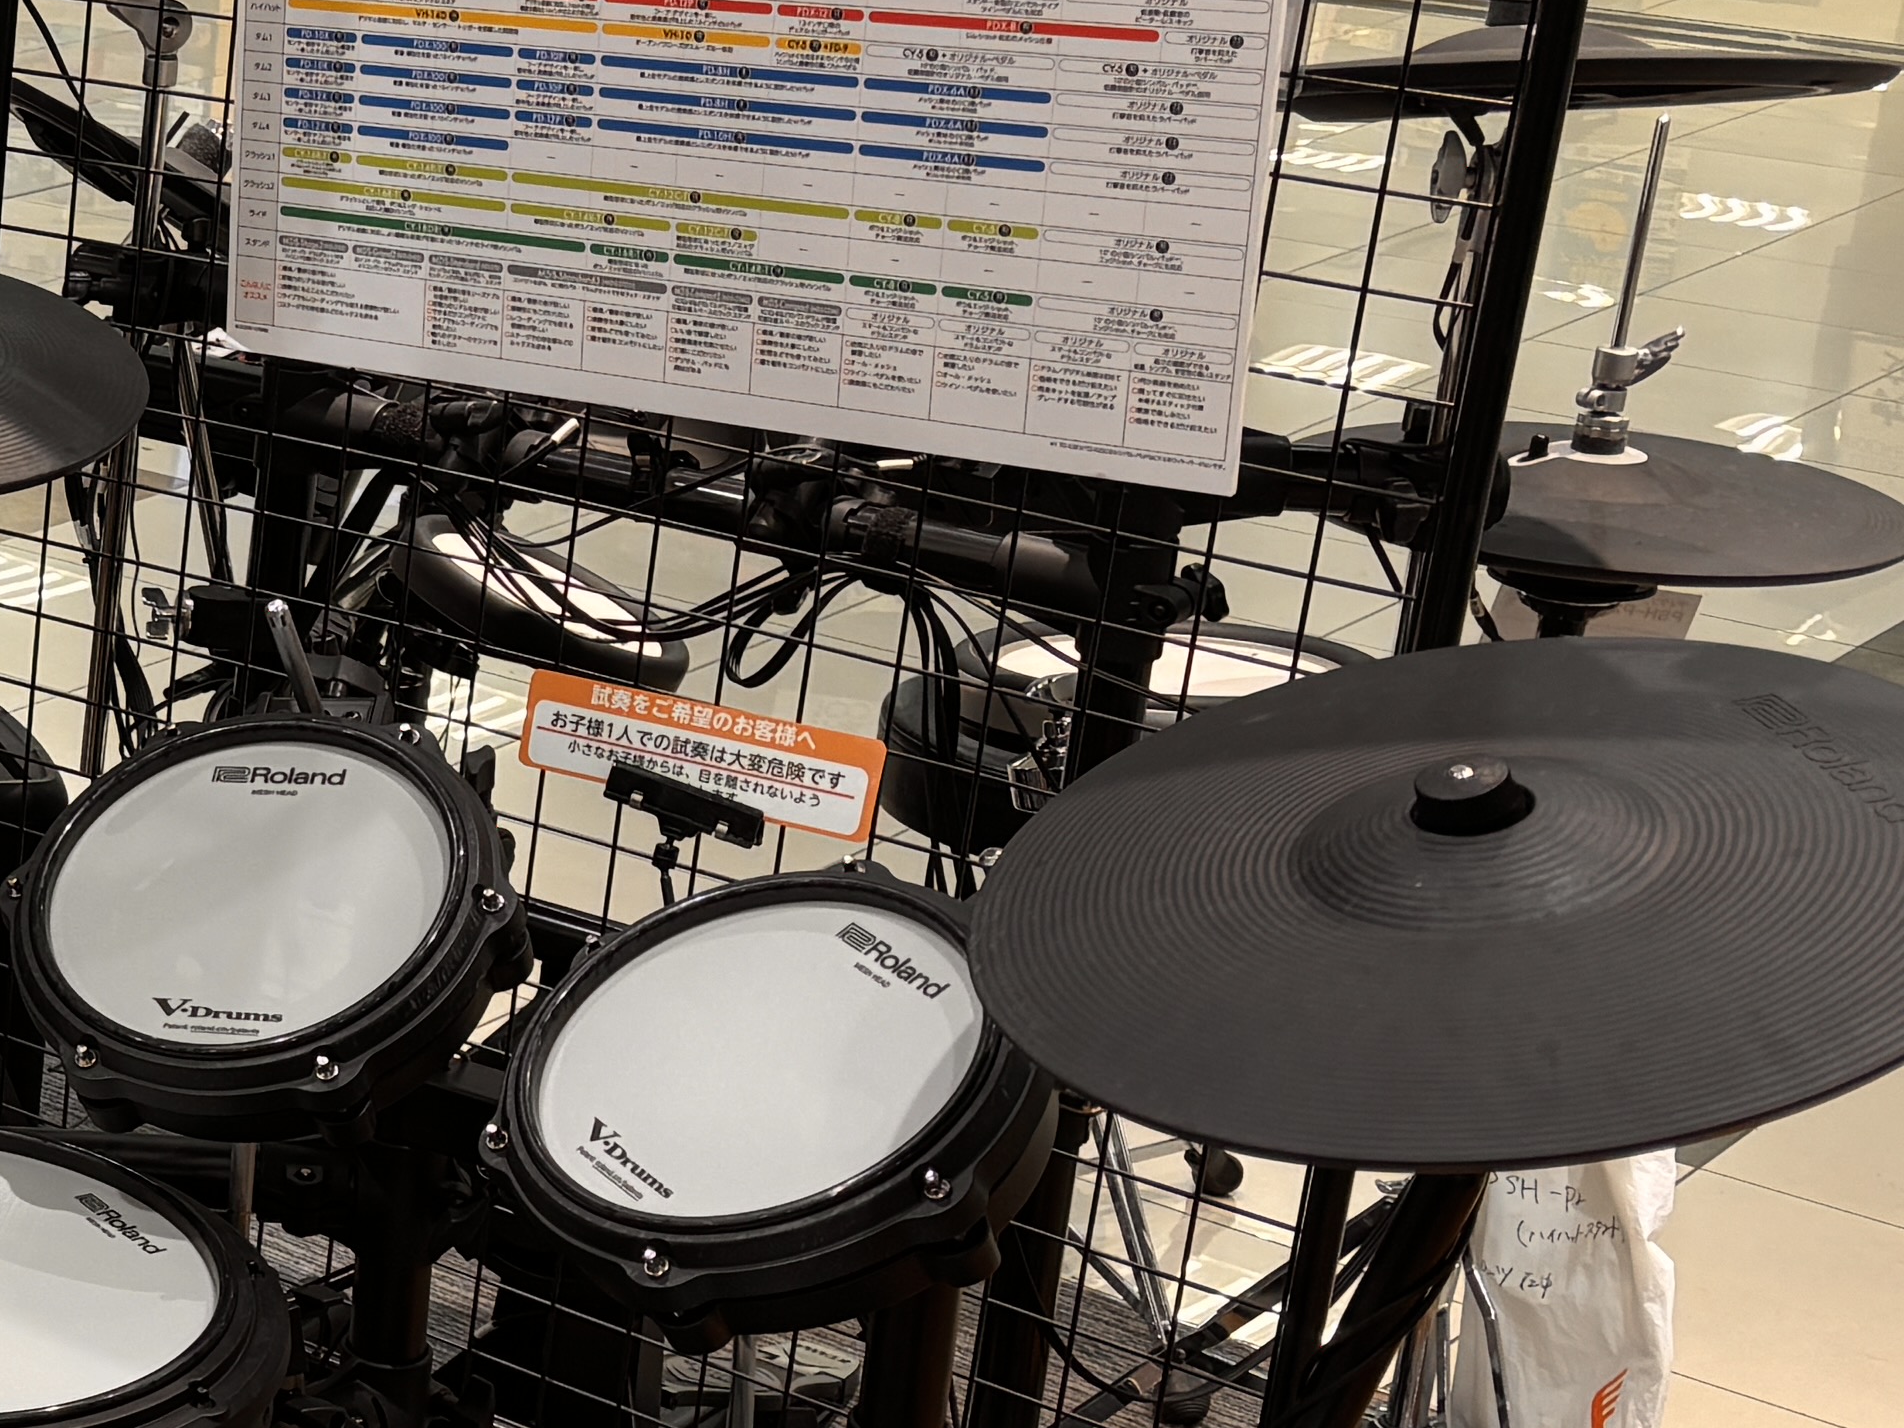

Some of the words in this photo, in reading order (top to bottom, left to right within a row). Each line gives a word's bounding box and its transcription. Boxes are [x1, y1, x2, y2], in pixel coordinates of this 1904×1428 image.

[590, 684, 817, 751] 試奏をご希望のお客様へ
[249, 766, 348, 786] Roland
[549, 710, 847, 790] お子様1人での試奏は大変危険です
[864, 939, 953, 1001] Roland
[95, 1204, 169, 1255] Roland
